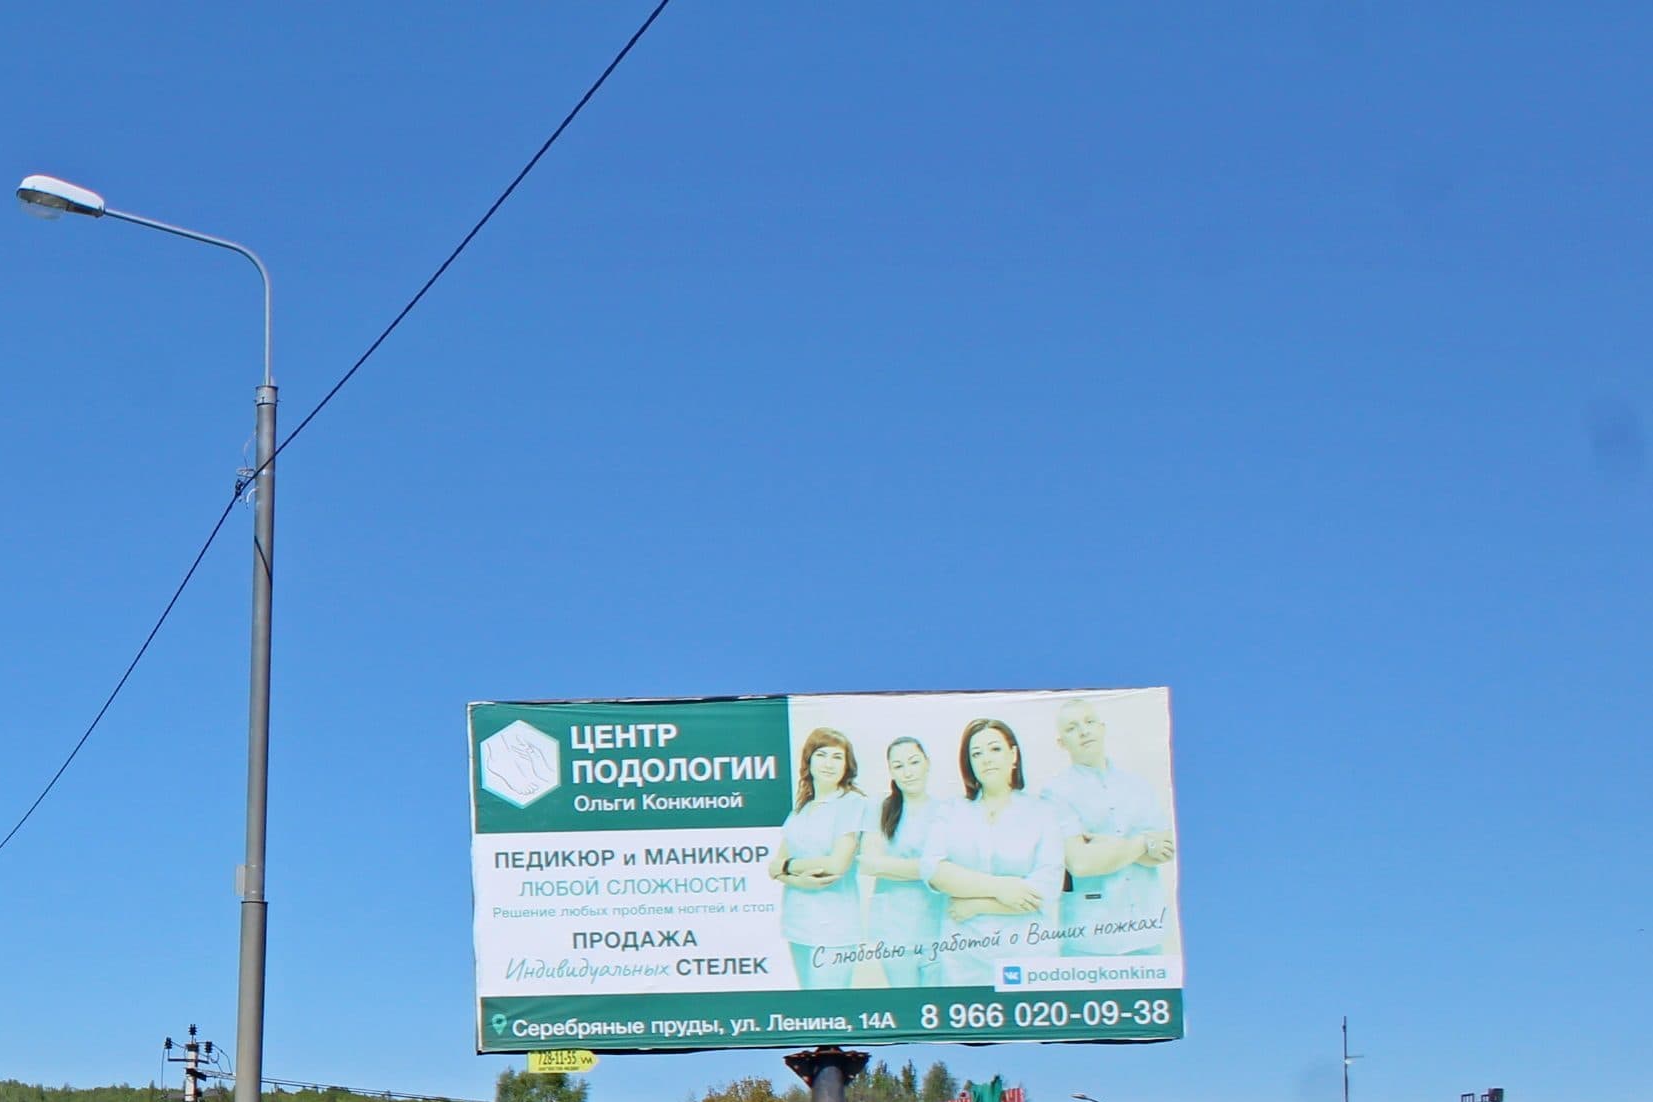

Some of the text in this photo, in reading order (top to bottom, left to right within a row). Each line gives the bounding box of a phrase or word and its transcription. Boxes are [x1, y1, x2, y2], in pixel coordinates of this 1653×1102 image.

[570, 723, 678, 754] ЦЕНТР
[571, 755, 777, 788] ПОДОЛОГИИ
[574, 792, 743, 812] Ольги Конкиной
[494, 846, 769, 871] ПЕДИКЮР и МАНИКЮР
[518, 876, 746, 897] ЛЮБОЙ СЛОЖНОСТИ
[492, 902, 775, 918] Решение любых проблем ногтей и стоп
[572, 930, 699, 951] ПРОДАЖА
[812, 906, 1167, 969] С любовью и заботой о Ваших ножках!
[505, 957, 769, 985] Индивидуальных СТЕЛЕК
[1028, 966, 1167, 984] podologkonkina
[511, 1018, 645, 1040] Серебряные
[650, 1018, 725, 1037] пруды,
[730, 1017, 761, 1036] ул.
[766, 1013, 853, 1033] Ленина,
[920, 1000, 1170, 1029] 8 966 020-09-38
